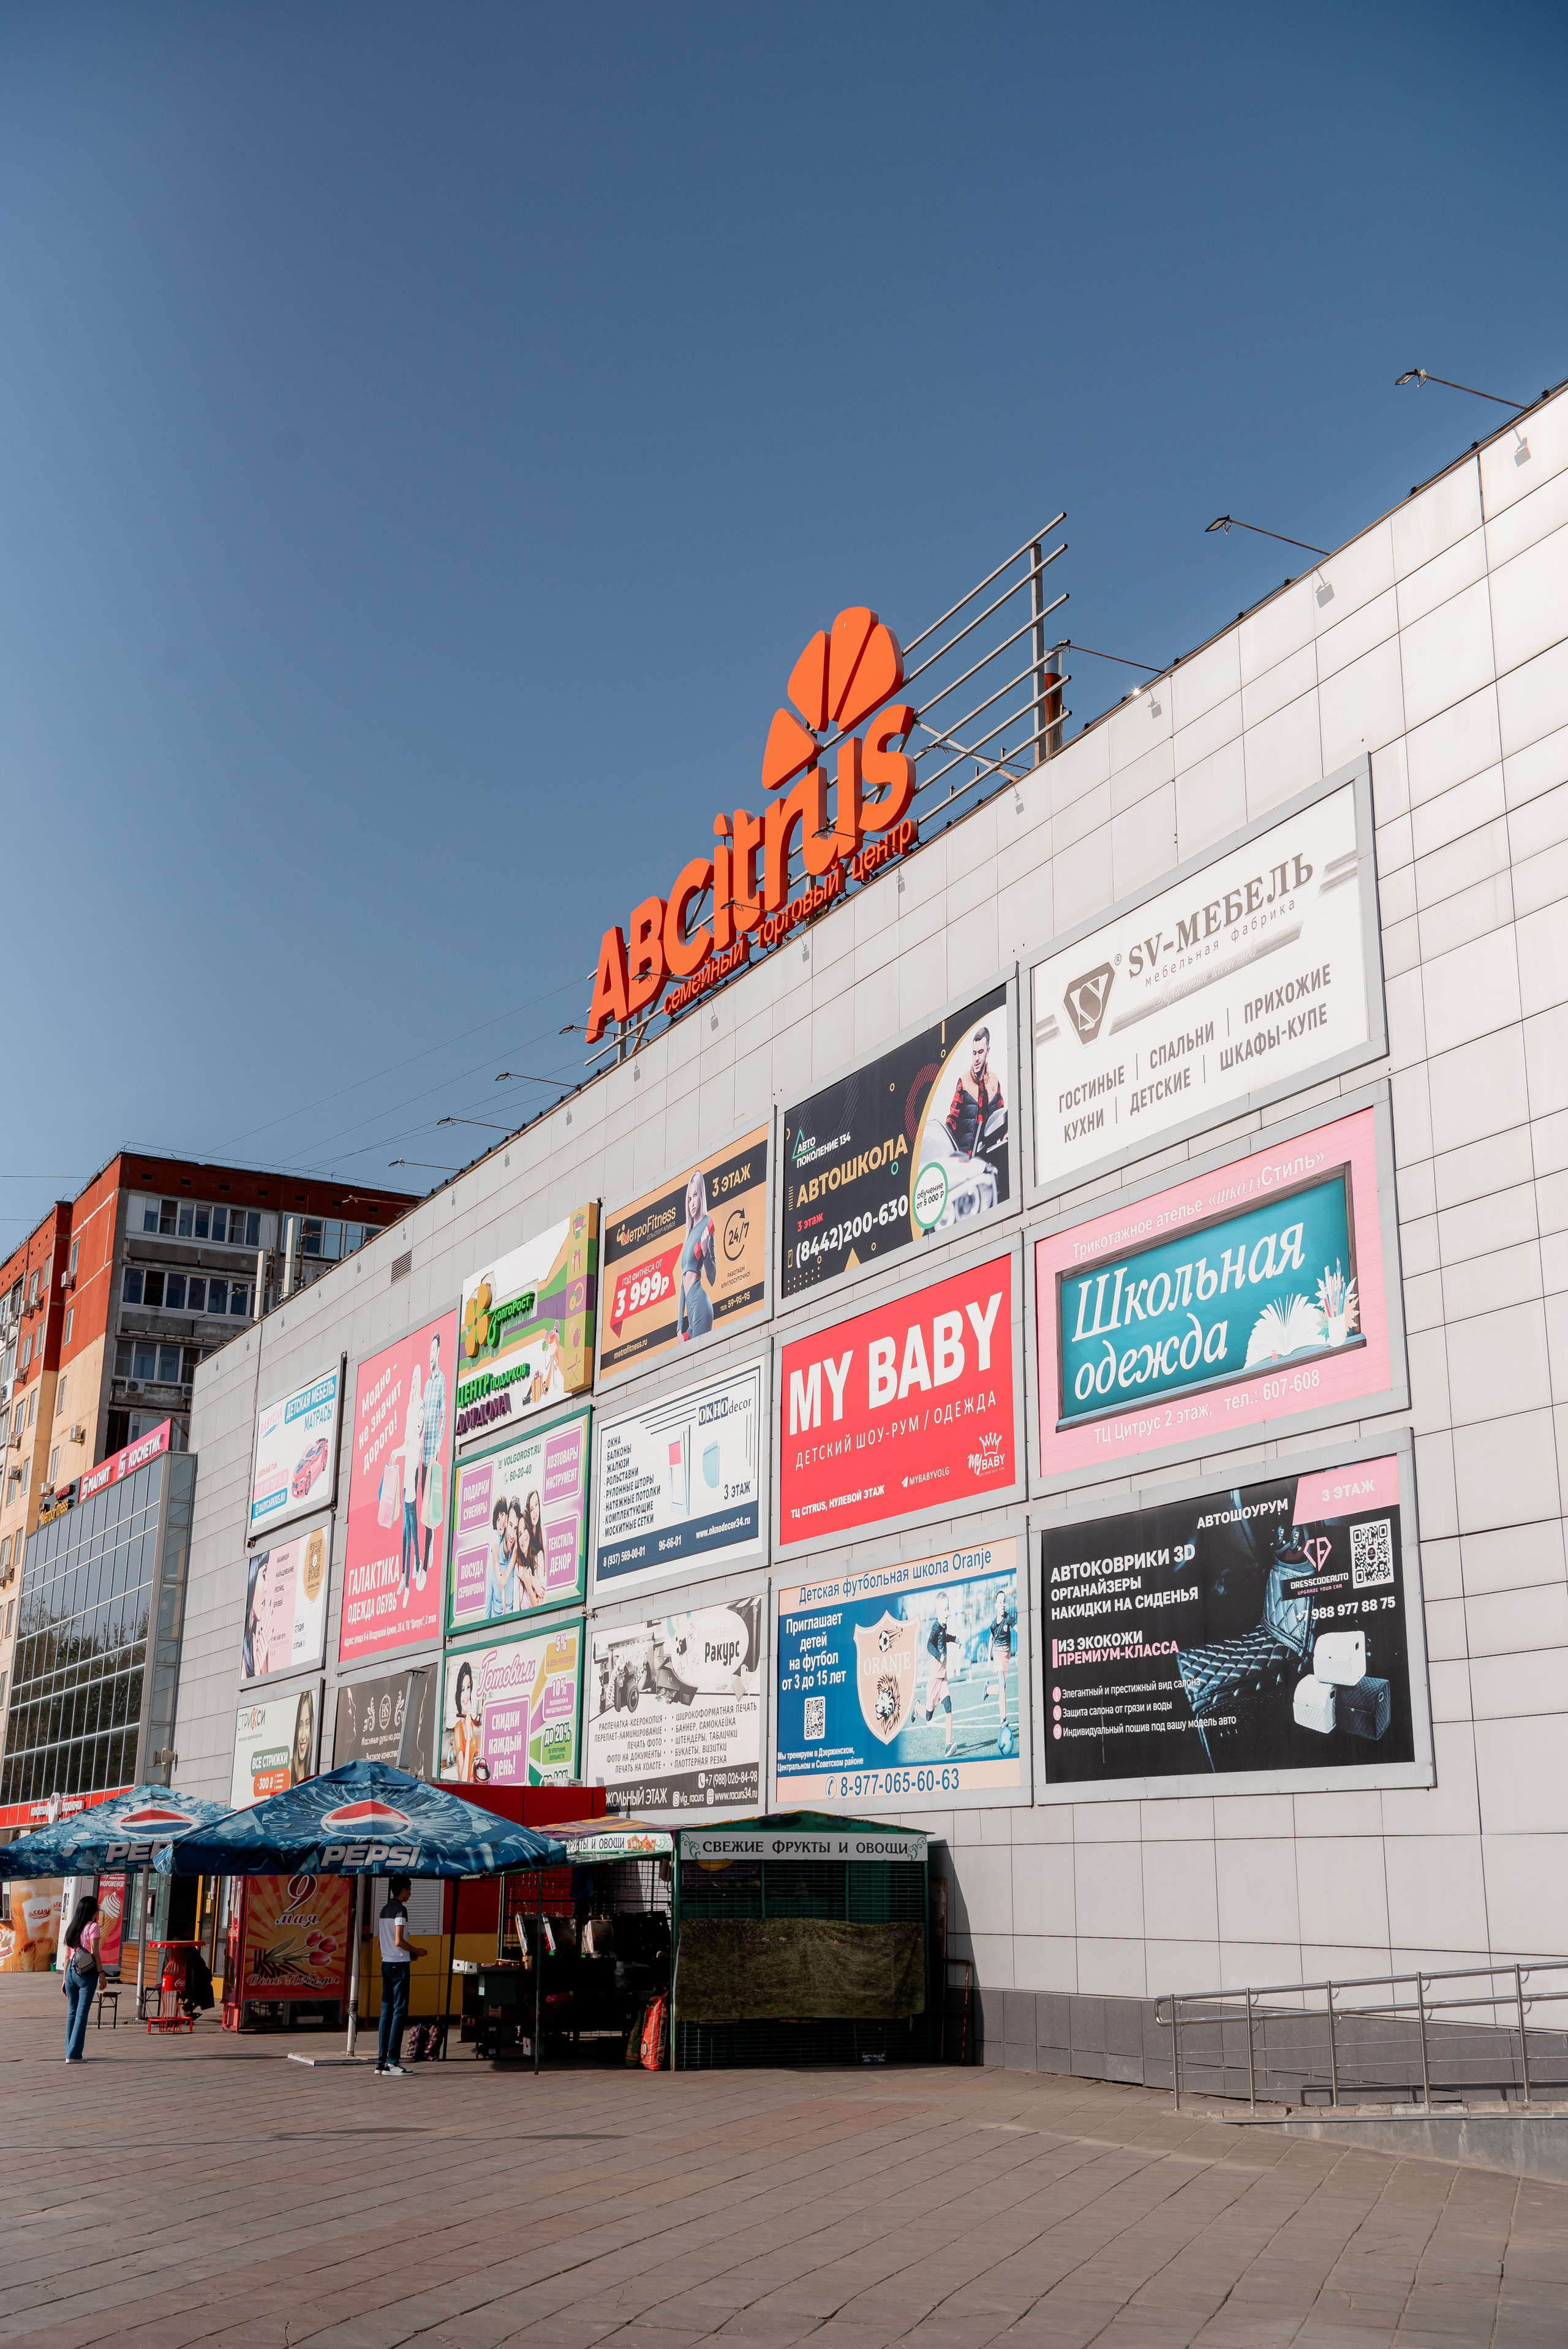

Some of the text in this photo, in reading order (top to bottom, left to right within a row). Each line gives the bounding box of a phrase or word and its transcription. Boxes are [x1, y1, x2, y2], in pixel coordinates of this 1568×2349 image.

[663, 818, 918, 1016] семейный торговый центр
[1128, 853, 1314, 979] SV-МЕБЕЛЬ
[1145, 899, 1295, 987] мебельная фабрика
[1058, 964, 1331, 1114] ГОСТИНЫЕ СПАЛЬНИ ПРИХОЖИЕ
[1063, 1003, 1327, 1142] КУХНИ ДЕТСКИЕ ШКАФЫ-КУПЕ
[797, 1137, 816, 1154] АВТО
[797, 1131, 851, 1168] ПОКОЛЕНИЕ 134
[712, 1163, 751, 1197] 3 ЭТАЖ
[797, 1134, 908, 1208] АВТОШКОЛА
[917, 1182, 944, 1201] обучение
[728, 1221, 750, 1246] 24/7
[796, 1194, 908, 1269] (8442)200-630
[797, 1212, 823, 1232] 3 этаж
[1072, 1218, 1153, 1261] Трикотажное
[1156, 1197, 1202, 1228] ателье
[622, 1259, 663, 1286] ГОД ФИТНЕСА ОТ
[1072, 1223, 1305, 1343] Школьная
[615, 1288, 625, 1318] 3
[728, 1291, 750, 1309] 59-95-95
[614, 1338, 647, 1359] metrofitness.ru
[1074, 1312, 1228, 1400] одежда
[790, 1291, 1003, 1436] MY BABY
[361, 1371, 390, 1413] Модно
[456, 1363, 530, 1408] ЦЕНТР ПОДАРКОВ
[286, 1379, 334, 1420] ДЕТСКАЯ МЕБЕЛЬ
[1094, 1369, 1320, 1446] ТЦ Цитрус 2 этаж, тел.: 607-608
[304, 1403, 333, 1432] МАТРАСЫ
[358, 1379, 402, 1450] не значит
[456, 1393, 511, 1436] ДЛЯ ДОМА
[607, 1436, 620, 1449] ОКНА
[796, 1435, 851, 1471] ДЕТСКИЙ
[857, 1416, 919, 1449] ШОУ-РУМ
[934, 1390, 996, 1425] ОДЕЖДА
[363, 1417, 398, 1475] дорого!
[504, 1444, 541, 1467] VOLGOROST.RU
[547, 1445, 578, 1469] ХОЗТОВАРЫ
[607, 1444, 631, 1461] БАЛКОНЫ
[88, 1466, 111, 1493] МАГНИТ
[129, 1434, 164, 1469] КОСМЕТИК
[510, 1464, 532, 1481] 60-20-40
[606, 1457, 630, 1474] ЖАЛЮЗИ
[982, 1454, 1005, 1470] BABY
[546, 1468, 578, 1490] ИНСТРУМЕНТ
[606, 1466, 639, 1486] РОЛЬСТАВНИ
[909, 1467, 949, 1486] MYBABYVOLG
[464, 1479, 489, 1501] ПОДАРКИ
[724, 1480, 750, 1500] 3 ЭТАЖ
[791, 1485, 884, 1518] ТЦ CITRUS, НУЛЕВОЙ ЭТАЖ
[1322, 1479, 1374, 1501] 3 ЭТАЖ
[463, 1501, 488, 1520] СУВЕНИРЫ
[605, 1501, 653, 1525] КОМПЛЕКТУЮЩИЕ
[1197, 1498, 1288, 1529] АВТОШОУРУМ
[696, 1517, 750, 1539] www.oknodecor34.ru
[548, 1531, 573, 1551] ТЕКСТИЛЬ
[659, 1535, 681, 1552] 96-66-01
[461, 1560, 483, 1580] ПОСУДА
[549, 1558, 571, 1576] ДЕКОР
[1050, 1544, 1196, 1583] АВТОКОВРИКИ 3D
[349, 1555, 400, 1597] ГАЛАКТИКА
[799, 1547, 992, 1605] Детская футбольная школа Oranje
[1291, 1573, 1349, 1589] DRESSCODEAUTO
[458, 1581, 484, 1599] СЕРВИРОВКА
[1051, 1576, 1142, 1601] ОРГАНАЙЗЕРЫ
[347, 1592, 397, 1626] ОДЕЖДА ОБУВЬ
[1051, 1586, 1198, 1620] НАКИДКИ НА СИДЕНЬЯ
[1297, 1596, 1395, 1621] +7 988 977 88 75
[786, 1612, 842, 1635] Приглашает
[704, 1640, 740, 1667] Ракурс
[799, 1632, 827, 1653] детей
[1058, 1631, 1143, 1653] ИЗ ЭКОКОЖИ
[1058, 1641, 1179, 1665] ПРЕМИУМ-КЛАССА
[476, 1650, 535, 1697] Готовим
[789, 1651, 839, 1673] на футбол
[864, 1651, 911, 1678] ORANJE
[1061, 1686, 1103, 1699] Элегантный
[1110, 1680, 1155, 1696] престижный
[1158, 1681, 1172, 1691] вид
[1174, 1677, 1200, 1688] салона
[492, 1710, 519, 1732] скидки
[676, 1702, 757, 1721] ШИРОКОФОРМАТНАЯ ПЕЧАТЬ
[676, 1716, 736, 1733] БАННЕР, САМОКЛЕЙКА
[488, 1732, 522, 1755] каждый
[252, 1752, 288, 1770] ВСЕ СТРИЖКИ
[493, 1755, 516, 1780] день!
[841, 1768, 960, 1797] 8-977-065-60-63
[680, 1792, 704, 1807] vlg_racurs
[715, 1789, 758, 1801] www.racurs34.ru
[105, 1839, 173, 1863] PEP
[320, 1845, 421, 1866] PEPSI
[592, 1839, 596, 1849] И
[599, 1838, 624, 1850] ОВОЩИ
[703, 1840, 908, 1855] СВЕЖИЕ ФРУКТЫ И ОВОЩИ
[100, 1879, 125, 1888] МОРОЖЕНОЕ
[284, 1874, 317, 1912] 9
[274, 1913, 319, 1928] мая
[246, 1971, 340, 1989] День Победы
